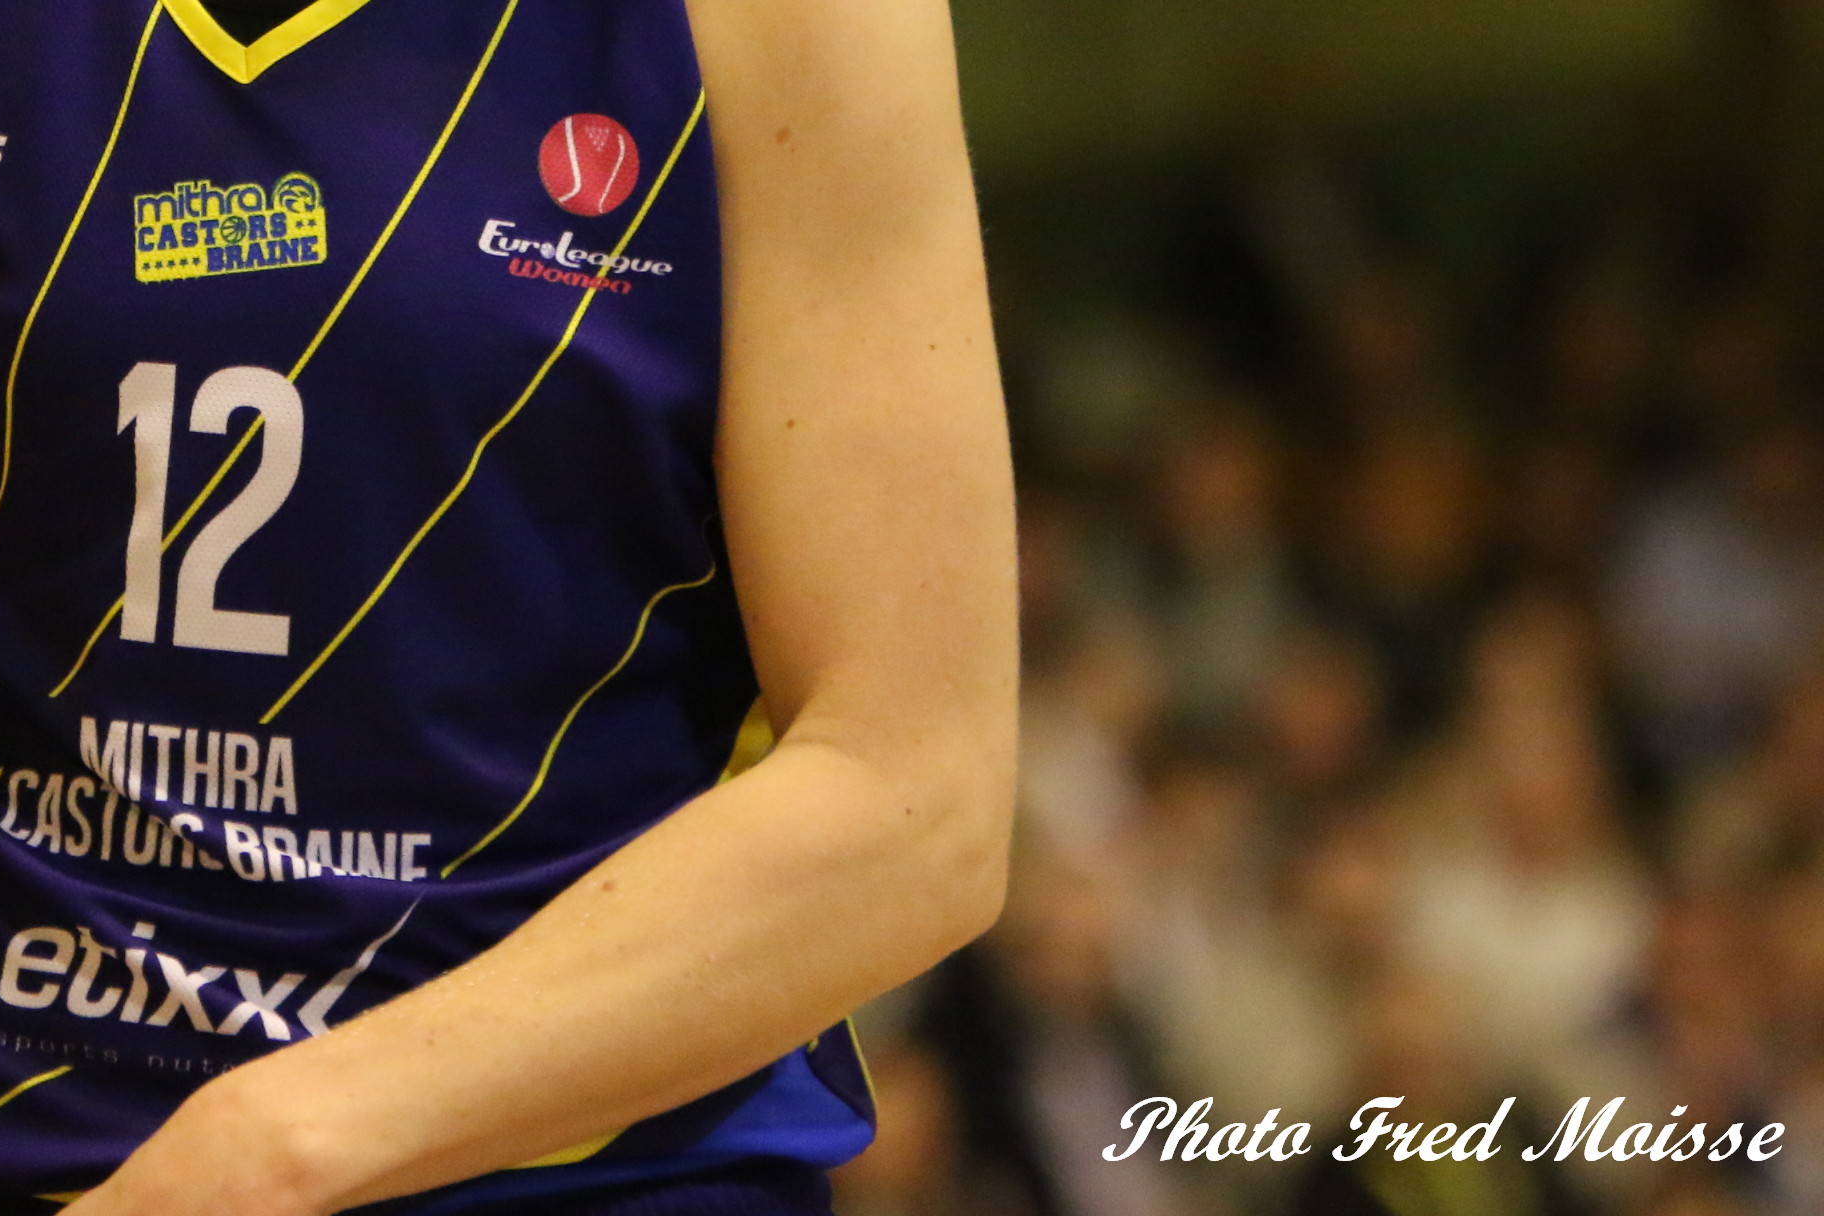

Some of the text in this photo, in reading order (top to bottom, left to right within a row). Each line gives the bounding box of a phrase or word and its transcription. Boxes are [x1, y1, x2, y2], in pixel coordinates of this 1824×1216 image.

[136, 181, 265, 224] mithra
[138, 212, 287, 252] CASTORS
[207, 235, 318, 272] BRAINE
[478, 219, 673, 276] EuroLeague
[508, 257, 631, 294] Women
[117, 361, 304, 656] 12
[80, 716, 298, 815] MITHRA
[224, 821, 431, 882] BRAINE
